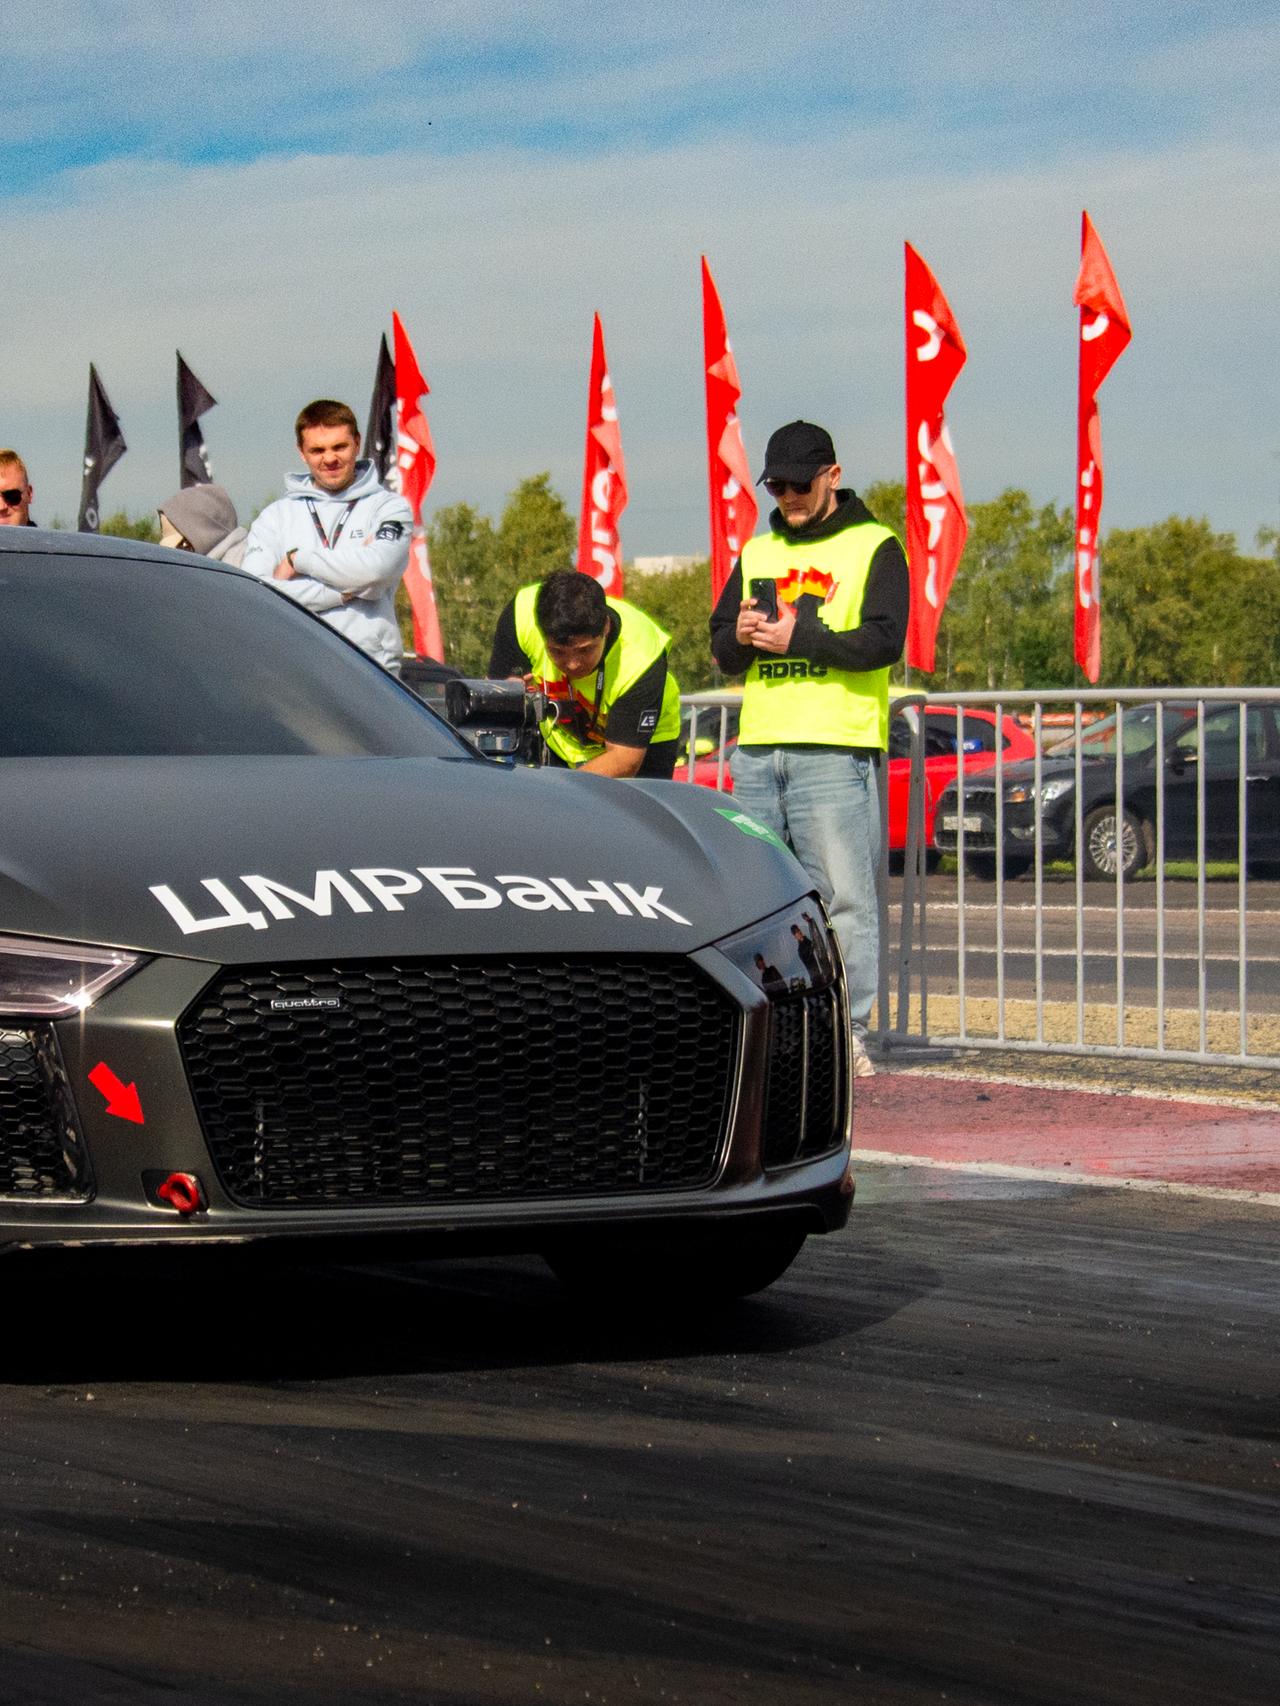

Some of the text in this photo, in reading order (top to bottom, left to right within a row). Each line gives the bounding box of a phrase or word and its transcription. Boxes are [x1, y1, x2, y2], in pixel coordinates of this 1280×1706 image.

[758, 661, 827, 680] RDRC
[148, 866, 693, 934] ЦМРБанк
[274, 998, 337, 1009] quattro
